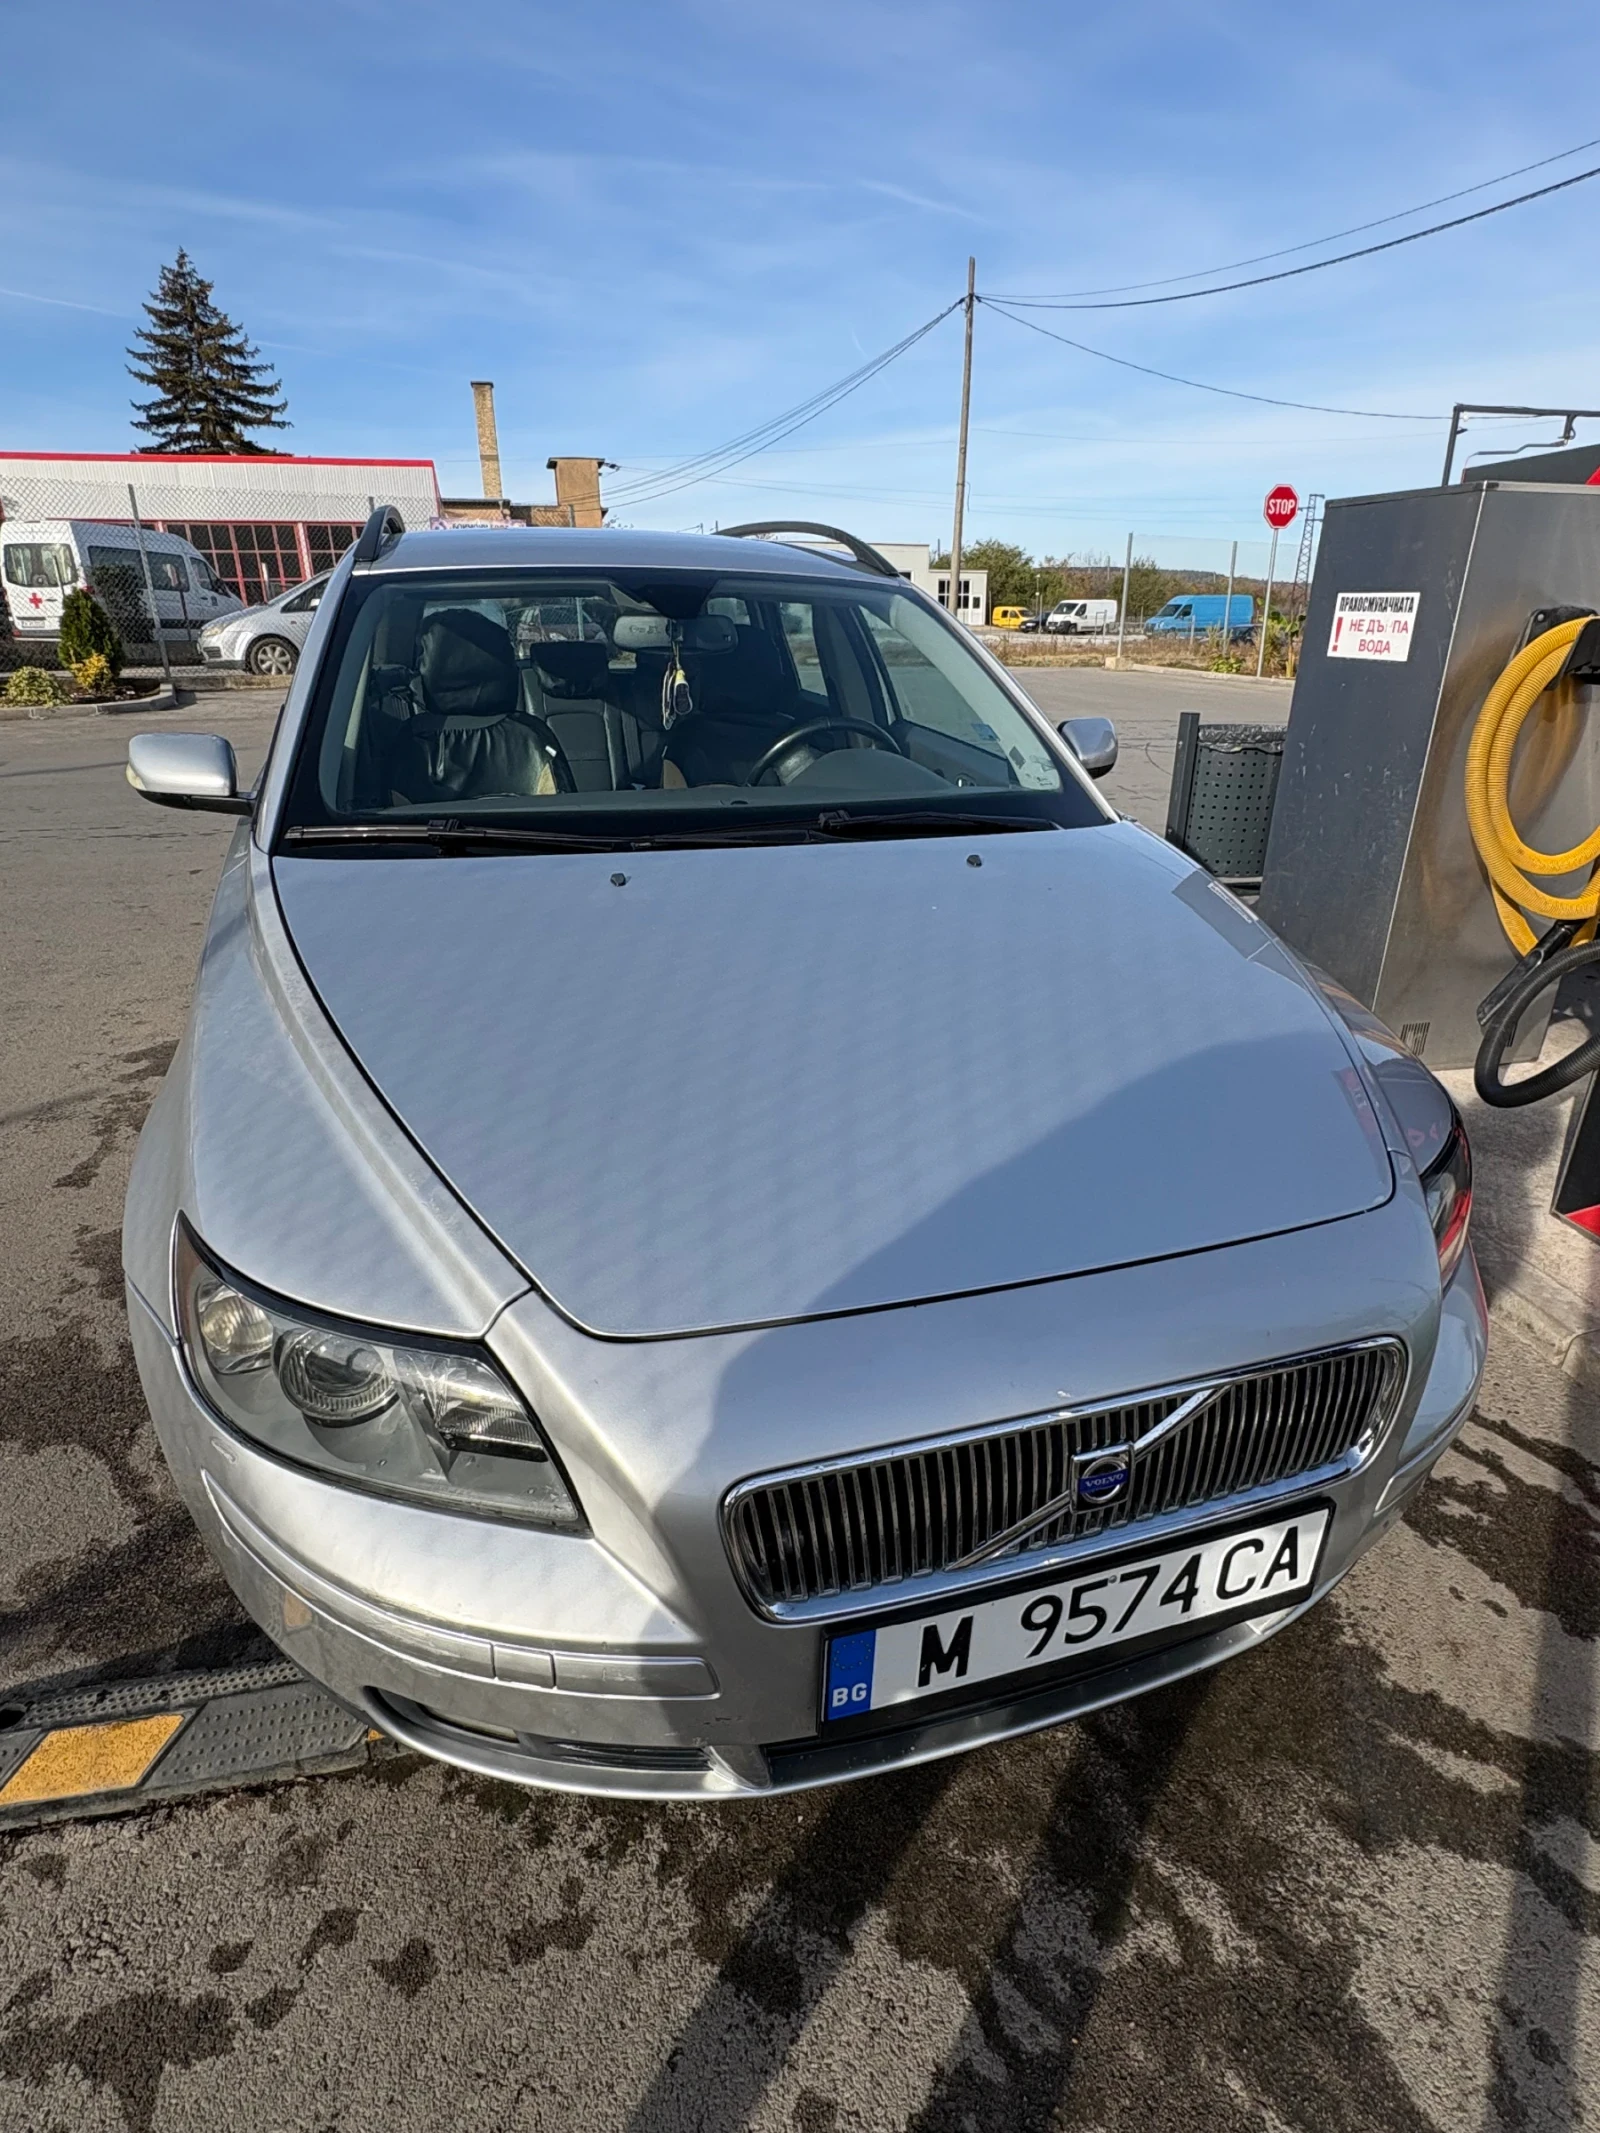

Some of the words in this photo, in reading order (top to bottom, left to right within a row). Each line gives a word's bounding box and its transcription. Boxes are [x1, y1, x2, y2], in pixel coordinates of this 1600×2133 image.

[1268, 499, 1295, 515] STOP
[1339, 597, 1414, 613] ПРАХОСМУКАЧКАТА
[1349, 619, 1365, 632] НЕ
[1358, 639, 1390, 655] ВОДА
[1085, 1474, 1123, 1487] VOLVO
[918, 1616, 973, 1687] M
[1020, 1554, 1201, 1658] 9574
[1216, 1526, 1298, 1600] CA
[832, 1684, 867, 1708] BG
